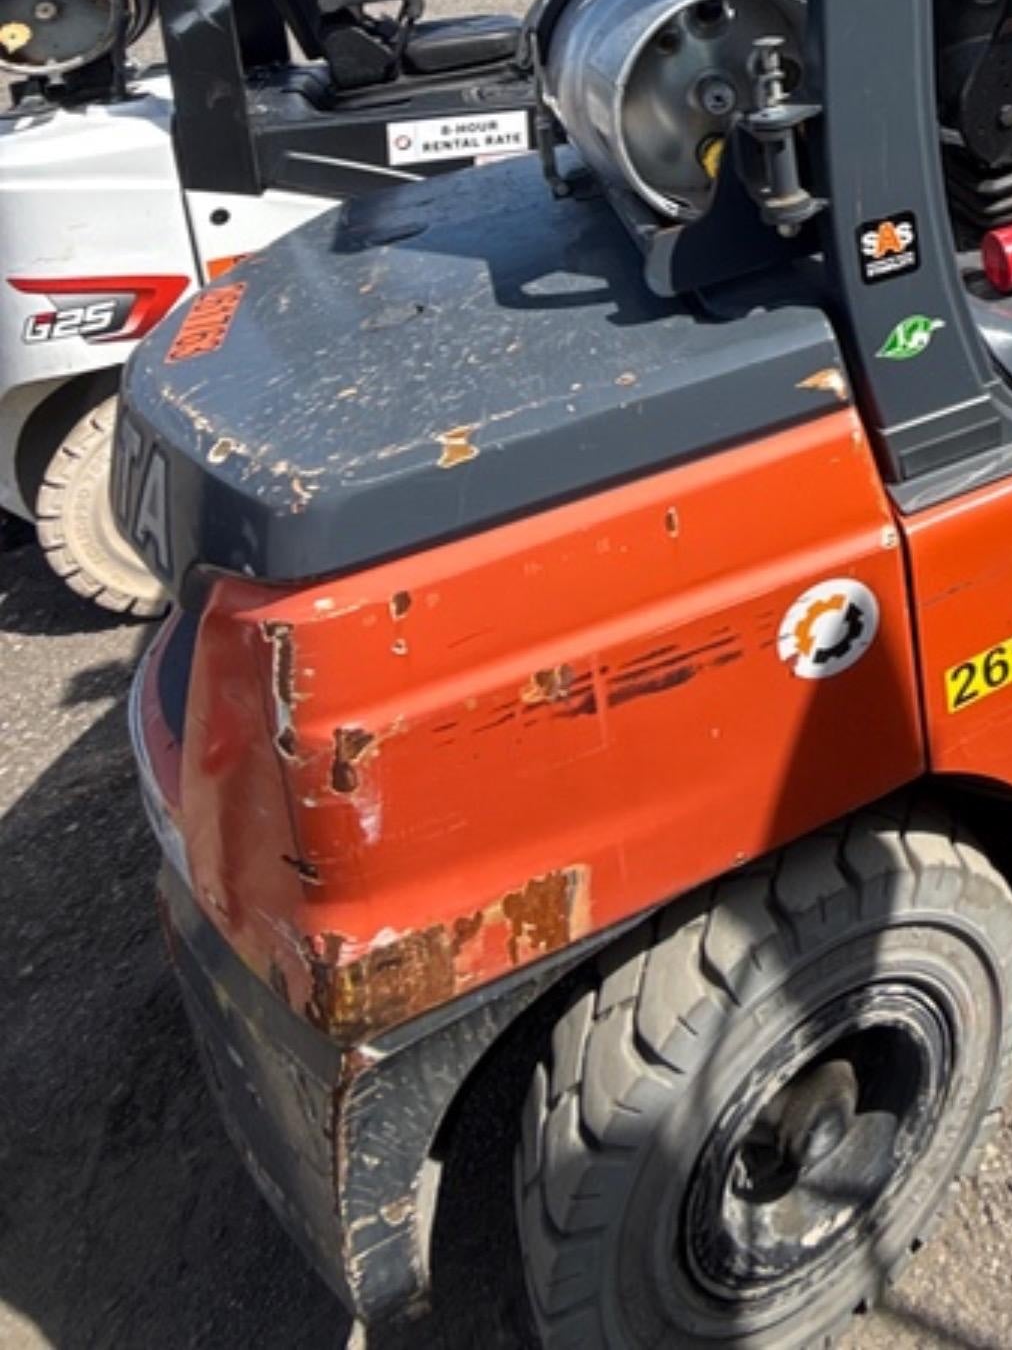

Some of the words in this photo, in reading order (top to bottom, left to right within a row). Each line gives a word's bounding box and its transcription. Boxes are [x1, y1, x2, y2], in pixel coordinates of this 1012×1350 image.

[422, 137, 480, 152] RENTAL
[485, 132, 521, 145] RATE
[861, 221, 914, 259] SAS
[22, 300, 117, 345] G25
